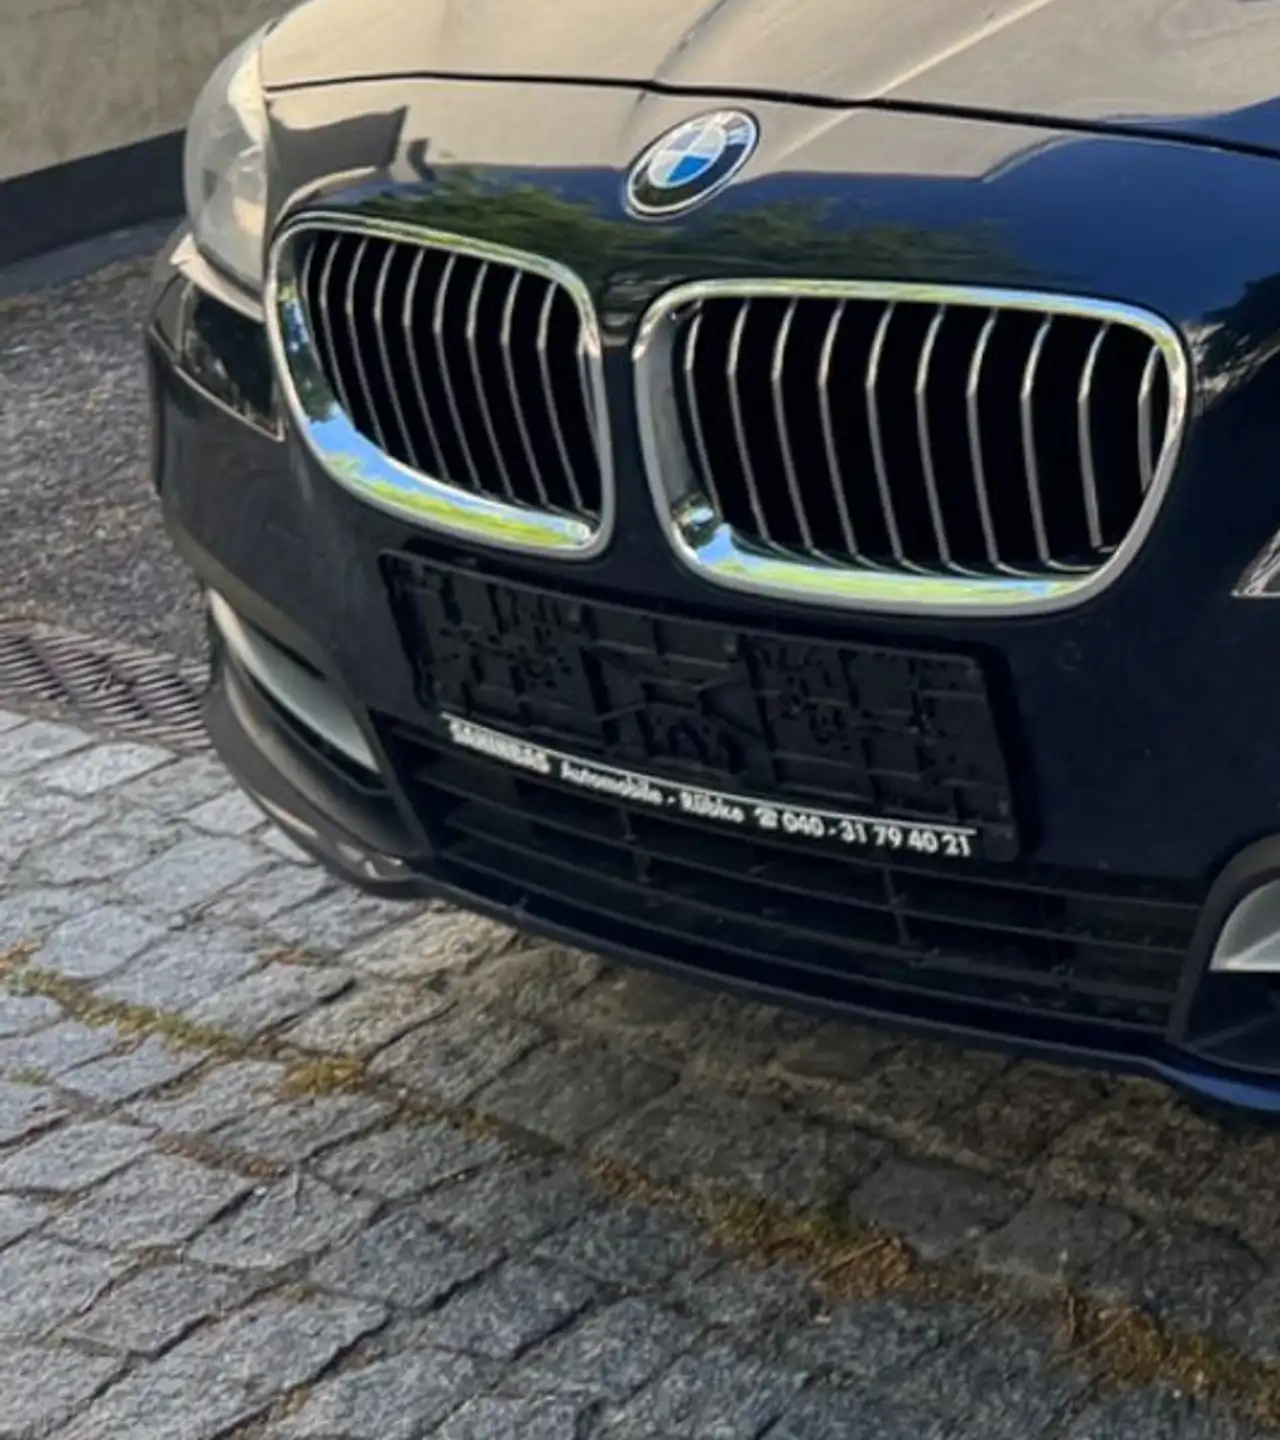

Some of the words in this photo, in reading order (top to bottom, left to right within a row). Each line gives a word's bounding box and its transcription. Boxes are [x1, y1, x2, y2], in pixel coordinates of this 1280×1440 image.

[561, 760, 663, 806] Automobile
[782, 810, 825, 838] 040
[839, 820, 868, 845] 31
[873, 825, 902, 849] 79
[908, 829, 939, 854] 40
[941, 833, 971, 857] 21
